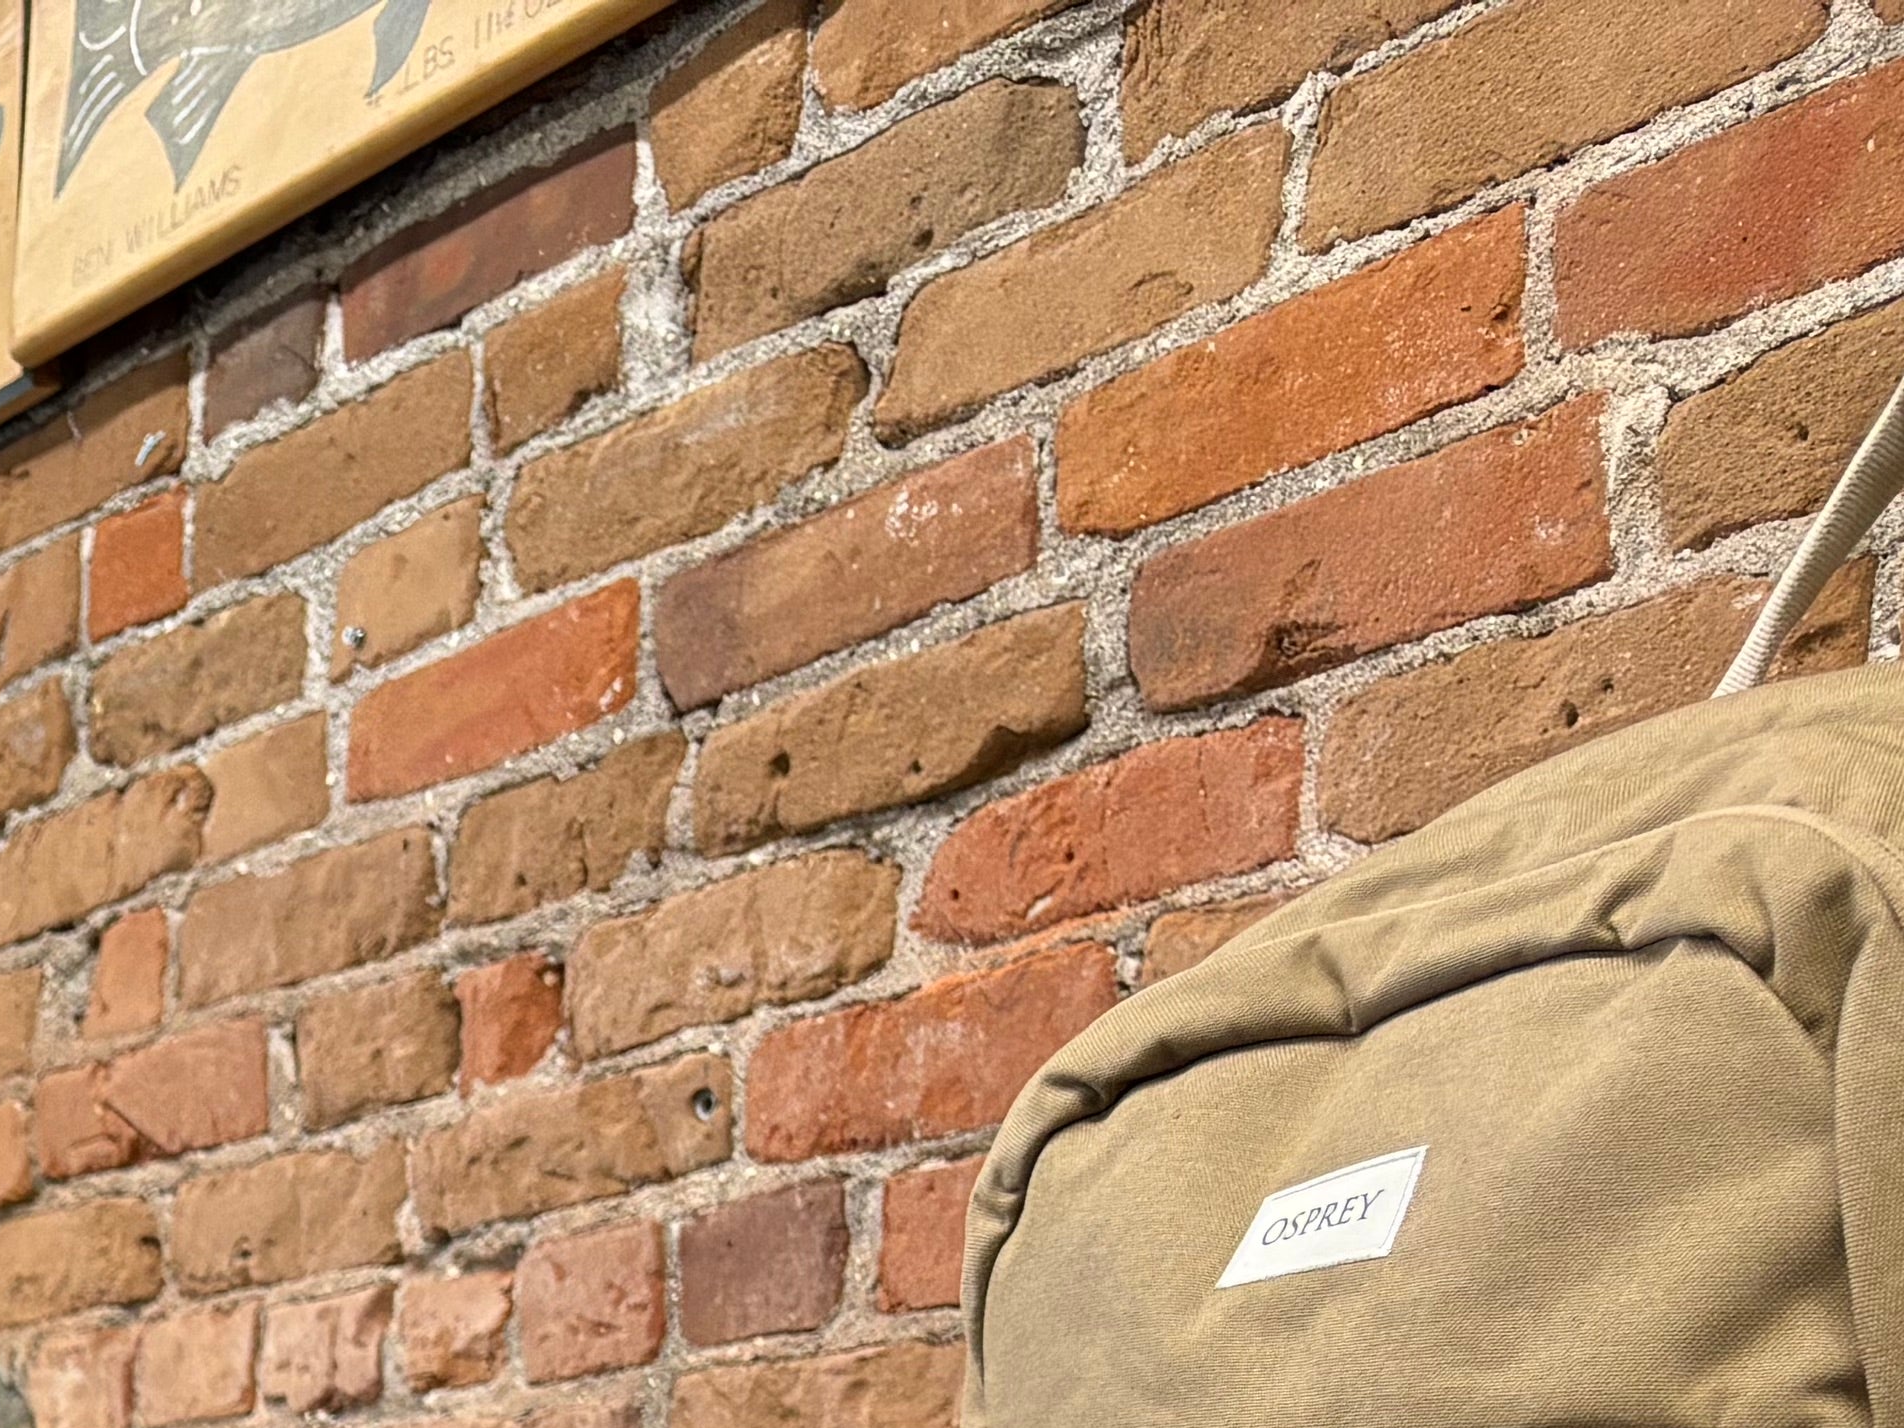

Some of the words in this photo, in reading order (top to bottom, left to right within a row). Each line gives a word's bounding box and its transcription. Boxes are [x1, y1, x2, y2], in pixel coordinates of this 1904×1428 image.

[398, 35, 456, 96] LBS
[125, 164, 242, 254] WILLIAMS
[1261, 1188, 1385, 1248] OSPREY
